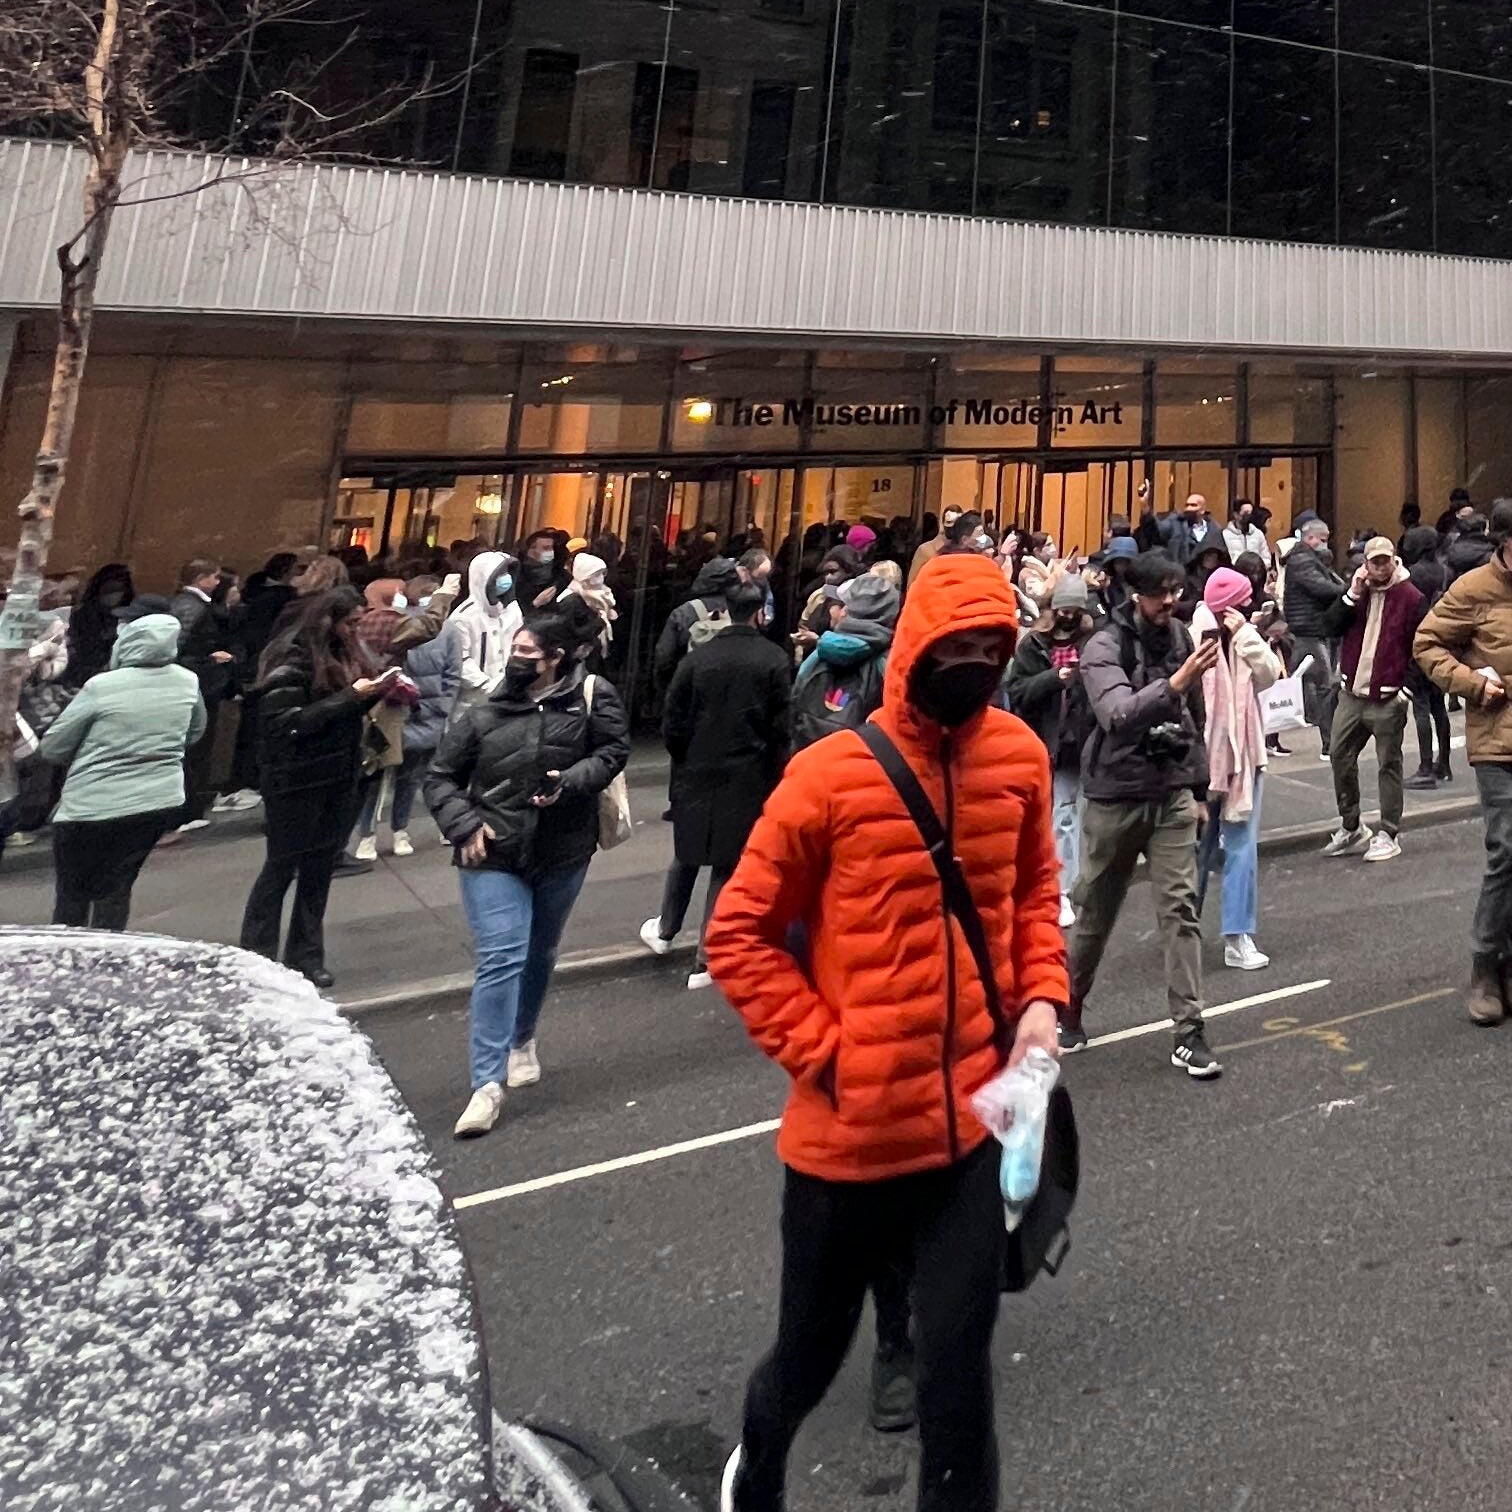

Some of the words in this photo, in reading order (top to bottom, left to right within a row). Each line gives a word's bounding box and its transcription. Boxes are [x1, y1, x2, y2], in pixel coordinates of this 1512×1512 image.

[715, 398, 774, 426] The
[783, 398, 920, 426] Museum
[929, 399, 958, 425] of
[964, 399, 1073, 425] Modern
[1079, 400, 1123, 425] Art
[872, 478, 892, 493] 18
